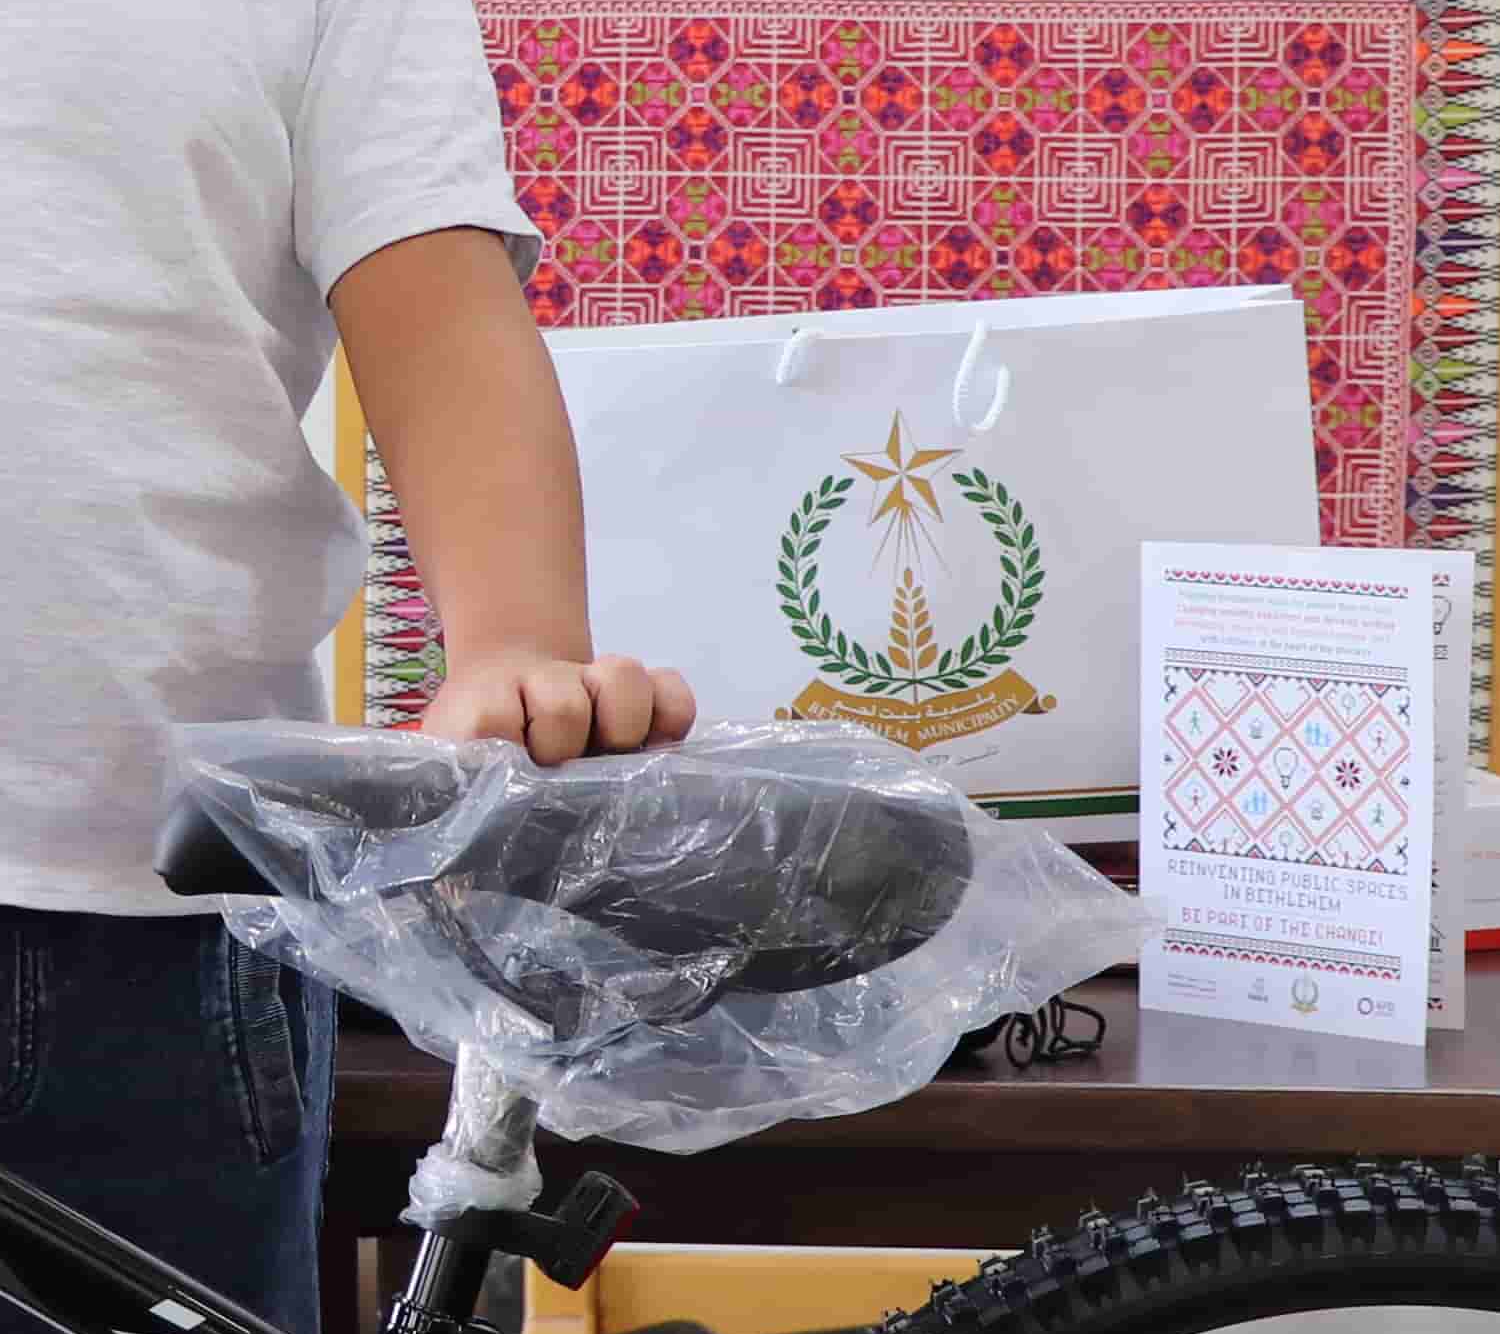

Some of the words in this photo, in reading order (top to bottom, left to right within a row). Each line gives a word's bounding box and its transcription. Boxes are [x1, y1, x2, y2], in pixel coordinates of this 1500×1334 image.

[1167, 858, 1276, 885] REINVENTING
[1281, 870, 1343, 893] PUBLIC
[1346, 879, 1409, 901] SPACES
[1223, 883, 1241, 900] IN
[1244, 886, 1342, 913] BETHLEHEM
[1181, 906, 1202, 924] BE
[1207, 909, 1248, 930] PART
[1253, 916, 1273, 933] OF
[1279, 918, 1311, 938] THE
[1314, 922, 1384, 947] CHANGE!
